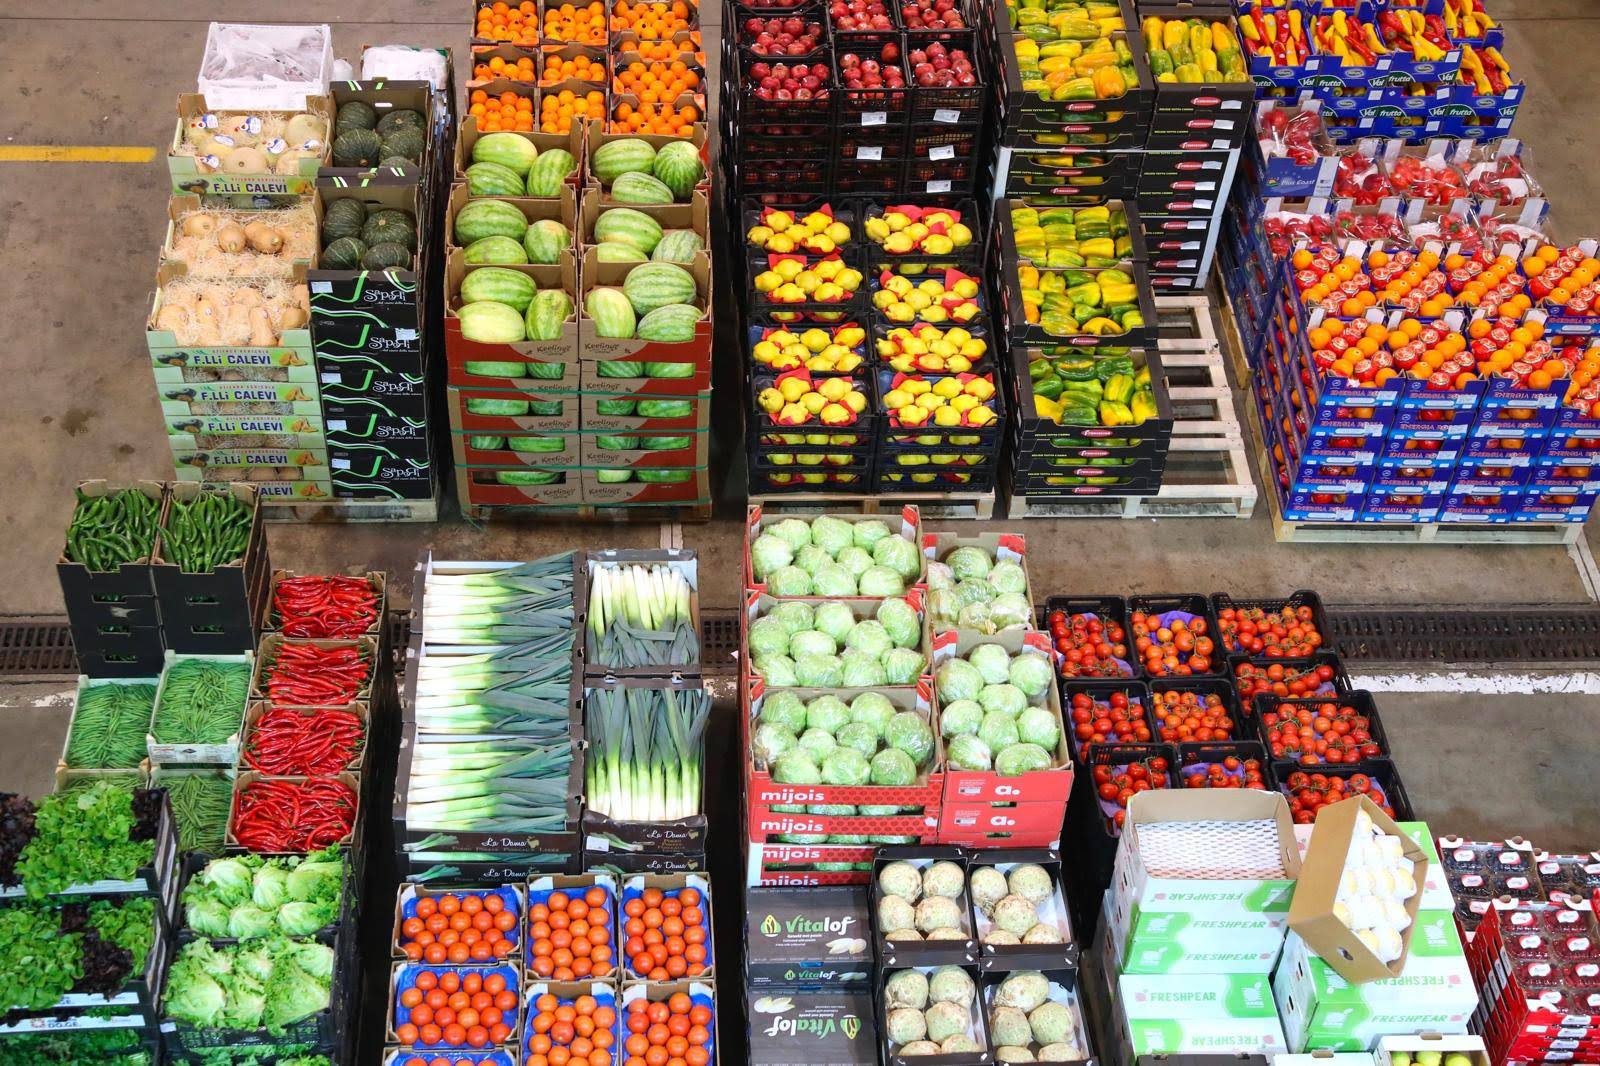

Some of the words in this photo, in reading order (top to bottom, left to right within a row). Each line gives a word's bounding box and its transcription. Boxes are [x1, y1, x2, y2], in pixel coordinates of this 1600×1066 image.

[246, 183, 288, 193] CALEVI
[227, 355, 271, 364] CALEVI
[234, 391, 276, 400] CALEVI
[240, 422, 283, 431] CALEVI
[246, 455, 288, 464] CALEVI
[260, 487, 293, 496] ALEVI
[995, 785, 1020, 795] a.
[761, 788, 824, 803] mijois
[761, 819, 824, 833] mijois
[990, 816, 1016, 826] a.
[481, 837, 498, 847] La
[500, 838, 528, 847] Dama
[762, 848, 821, 861] mijois
[1168, 892, 1244, 901] FRESHPEAR
[786, 914, 856, 935] Vitalof
[1192, 920, 1267, 928] FRESHPEAR
[1186, 953, 1258, 961] FRESHPEAR
[799, 970, 838, 980] Vitalof
[1150, 992, 1216, 1001] FRESHPEAR
[1371, 1014, 1448, 1023] FRESHPEAR
[763, 1016, 836, 1039] Vitalof
[1191, 1035, 1259, 1046] FRESHPEAR
